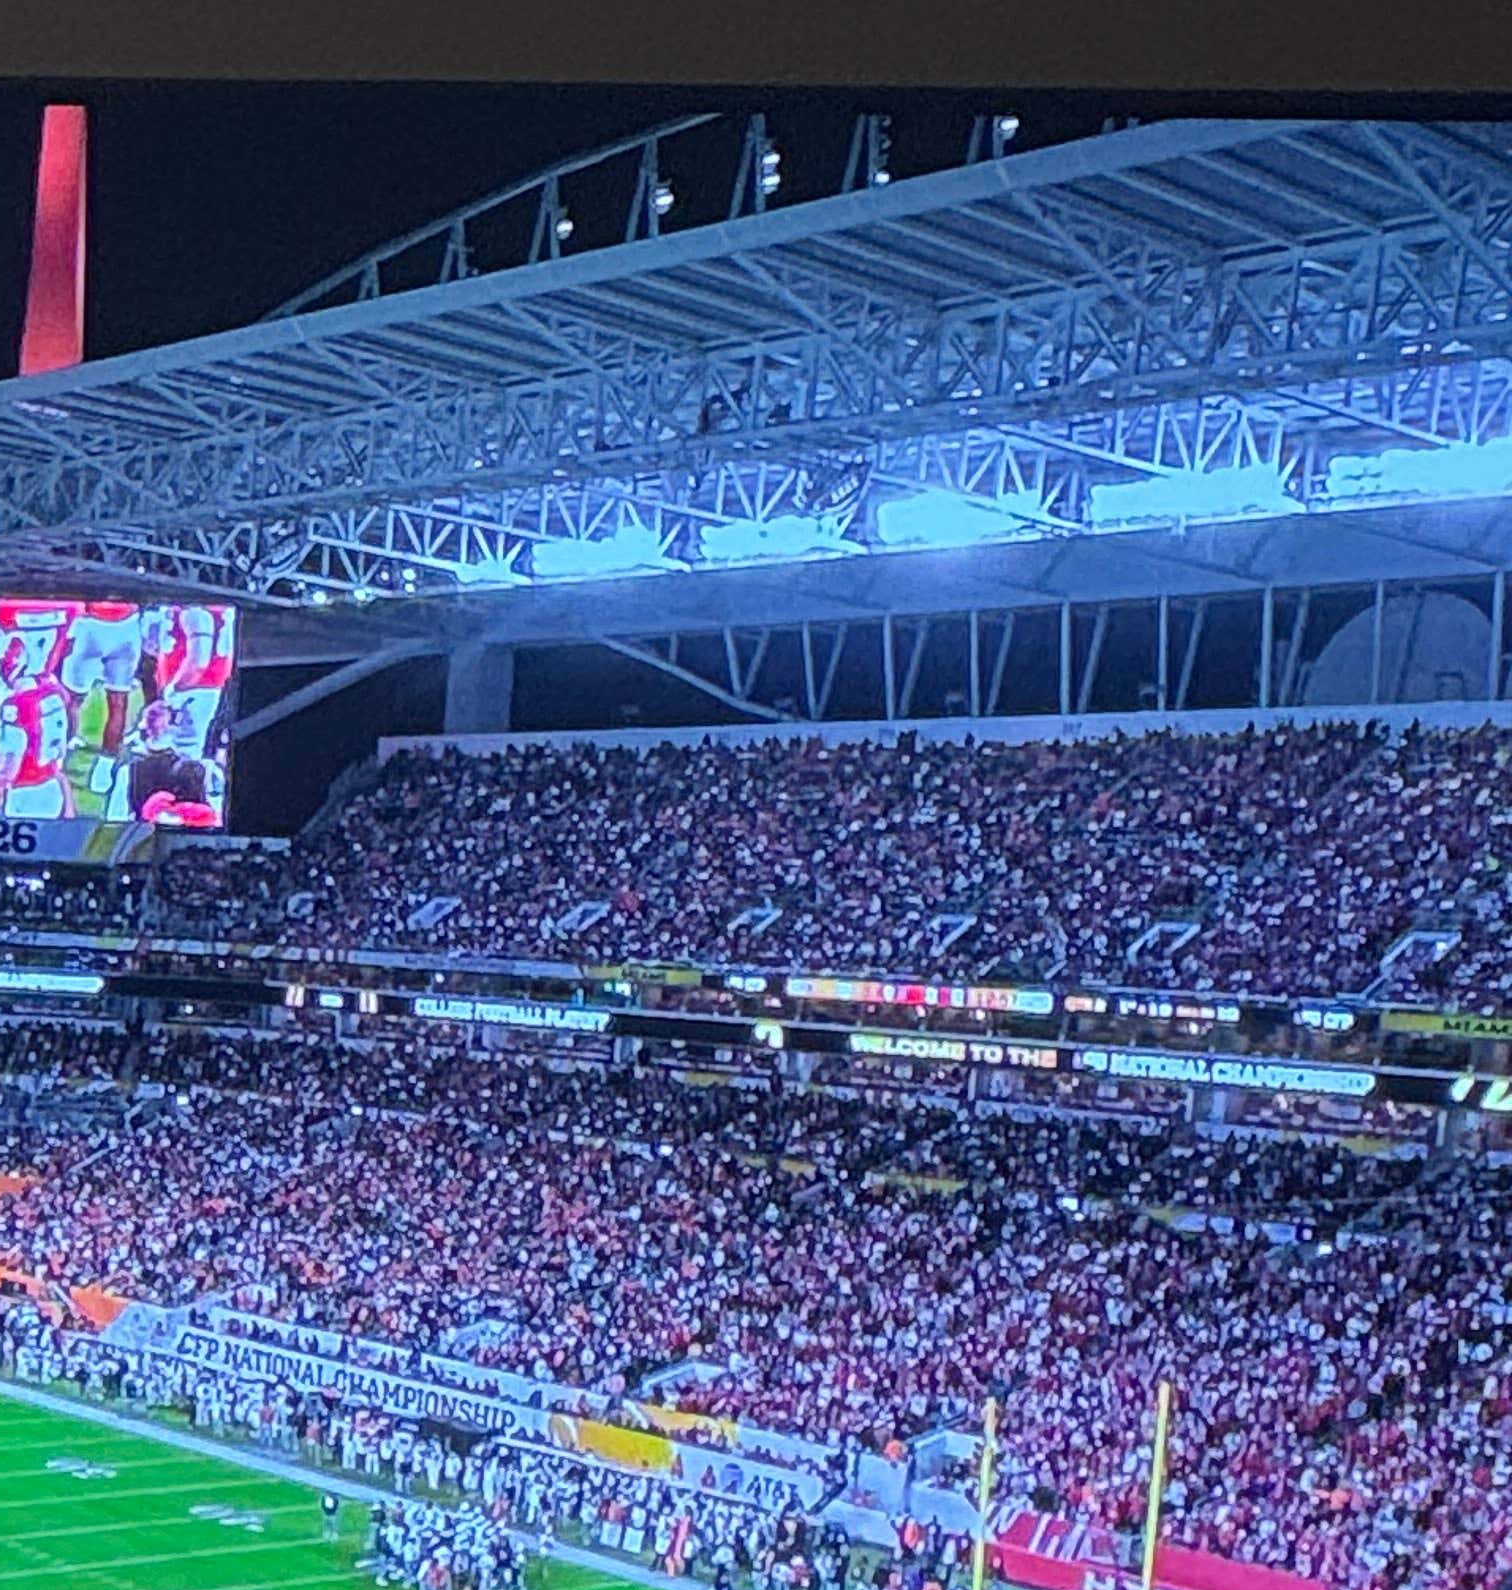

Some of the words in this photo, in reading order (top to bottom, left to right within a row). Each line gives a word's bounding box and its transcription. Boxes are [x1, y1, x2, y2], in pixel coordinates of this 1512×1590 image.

[1444, 1020, 1511, 1034] MIAM
[849, 1033, 966, 1062] WELCOME
[968, 1043, 1003, 1064] TO
[1006, 1046, 1057, 1069] THE
[177, 1331, 220, 1359] CFP
[224, 1340, 325, 1386] NATIONAL
[334, 1367, 516, 1438] CHAMPIONSHIP
